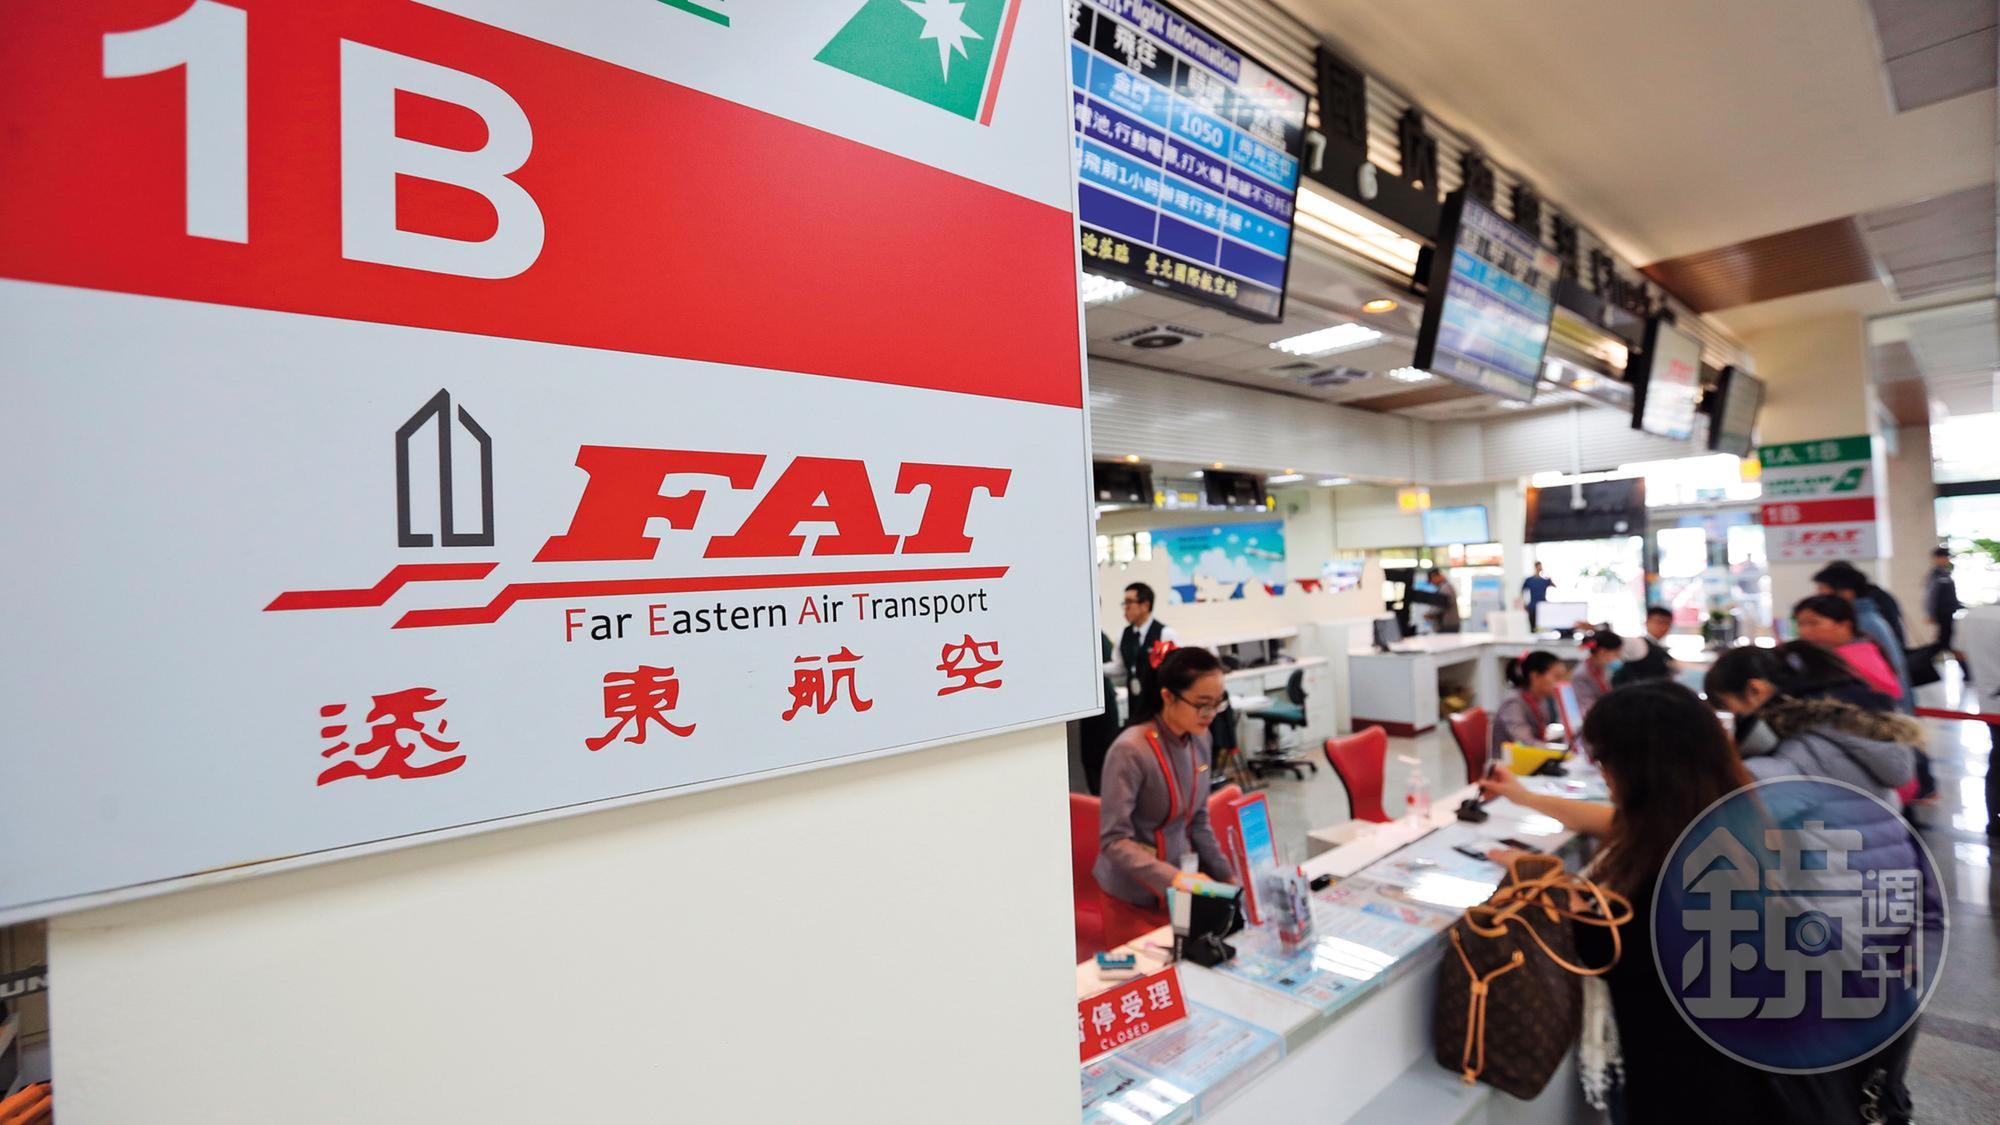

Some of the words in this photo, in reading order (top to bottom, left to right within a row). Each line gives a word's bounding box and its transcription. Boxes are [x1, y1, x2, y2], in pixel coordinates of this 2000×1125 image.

[1166, 14, 1241, 79] Information
[103, 0, 546, 280] 1B
[1180, 110, 1225, 150] 1050
[1306, 130, 1327, 172] 7
[1357, 161, 1379, 200] 6
[532, 445, 1012, 562] FAT
[565, 608, 632, 642] Far
[648, 602, 787, 637] Eastern
[798, 592, 844, 625] Air
[853, 586, 988, 624] Transport
[1100, 1021, 1150, 1050] CLOSED
